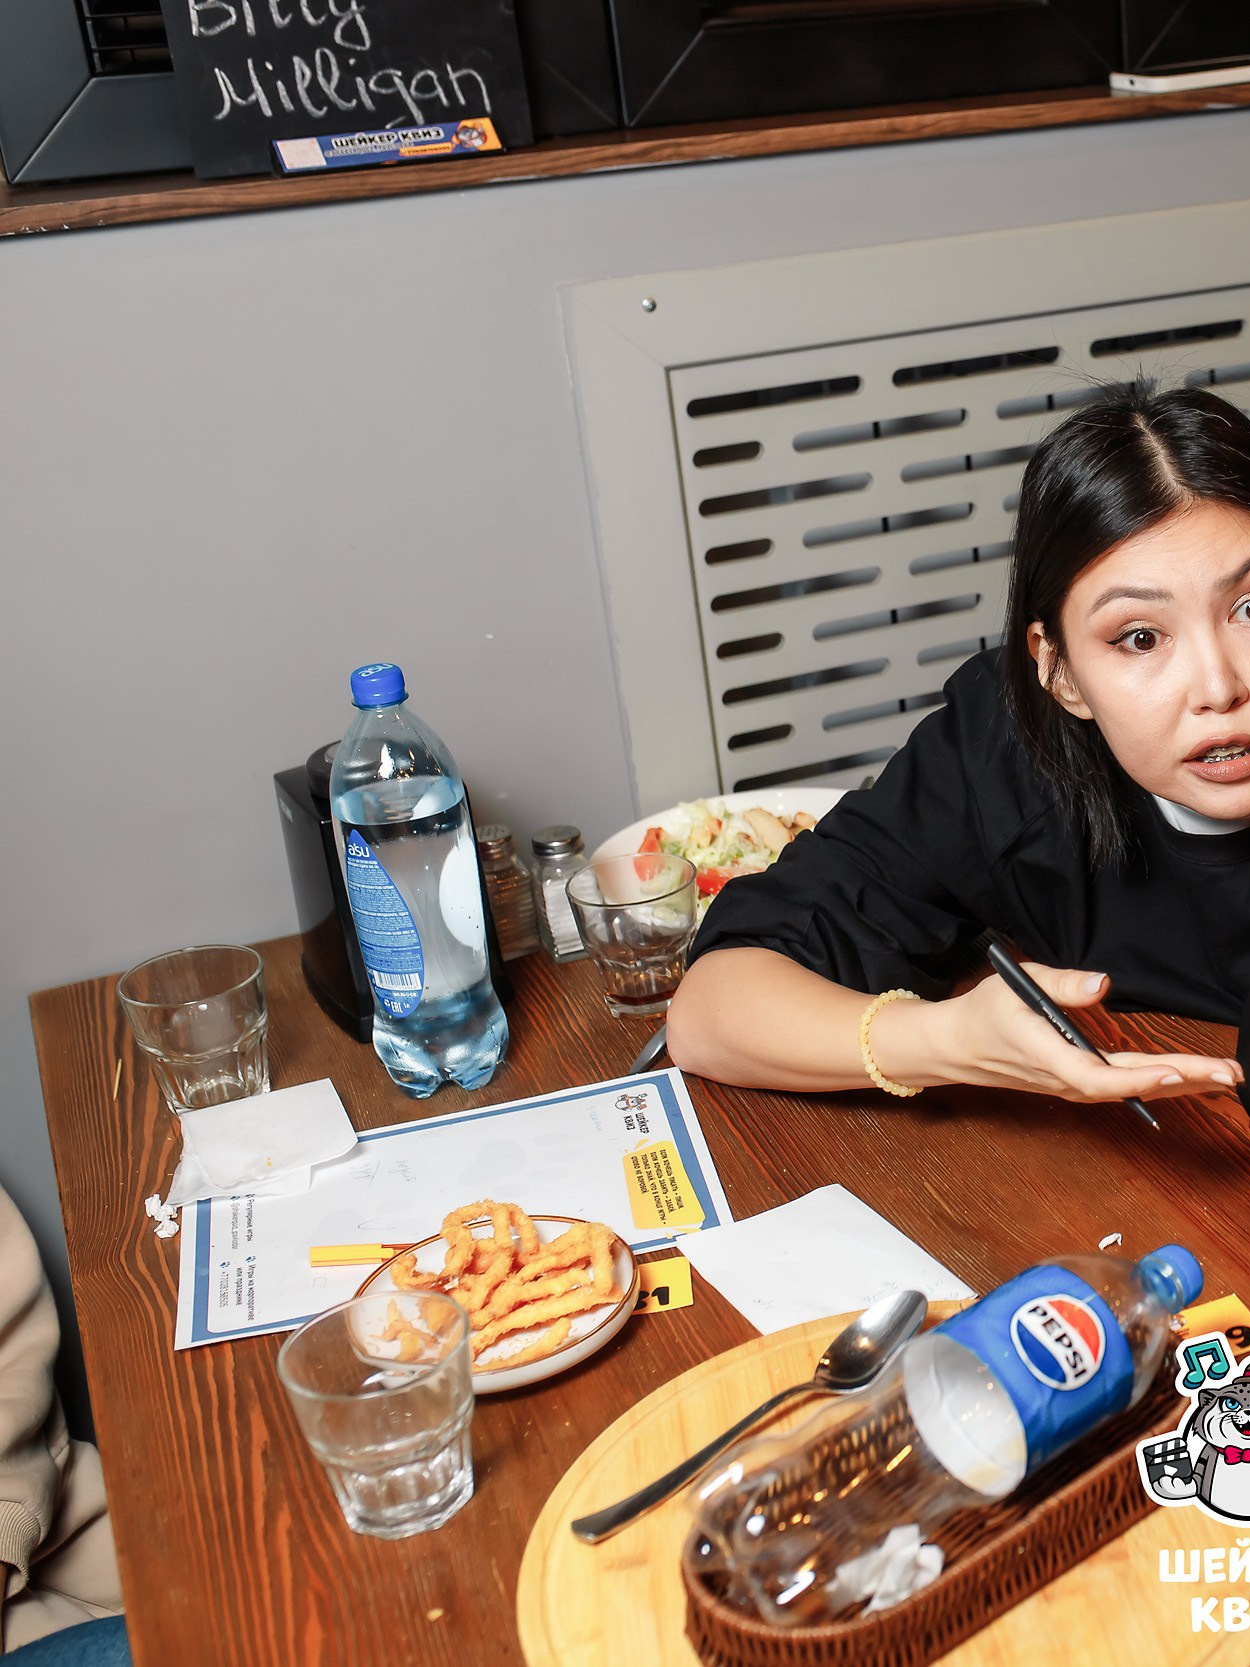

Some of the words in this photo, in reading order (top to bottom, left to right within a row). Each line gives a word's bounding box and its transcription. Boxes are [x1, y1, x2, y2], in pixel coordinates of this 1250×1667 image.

[213, 48, 492, 130] Milligan
[332, 131, 398, 149] ШЕЙКЕР
[400, 127, 443, 142] КВИЗ
[624, 1116, 635, 1130] КВИЗ
[635, 1112, 651, 1134] ШЕЙКЕР
[245, 1199, 255, 1228] Регулярные
[247, 1264, 256, 1279] Игры
[234, 1278, 243, 1306] празднике
[246, 1286, 255, 1321] корпоративе
[1028, 1306, 1086, 1378] PEPSI
